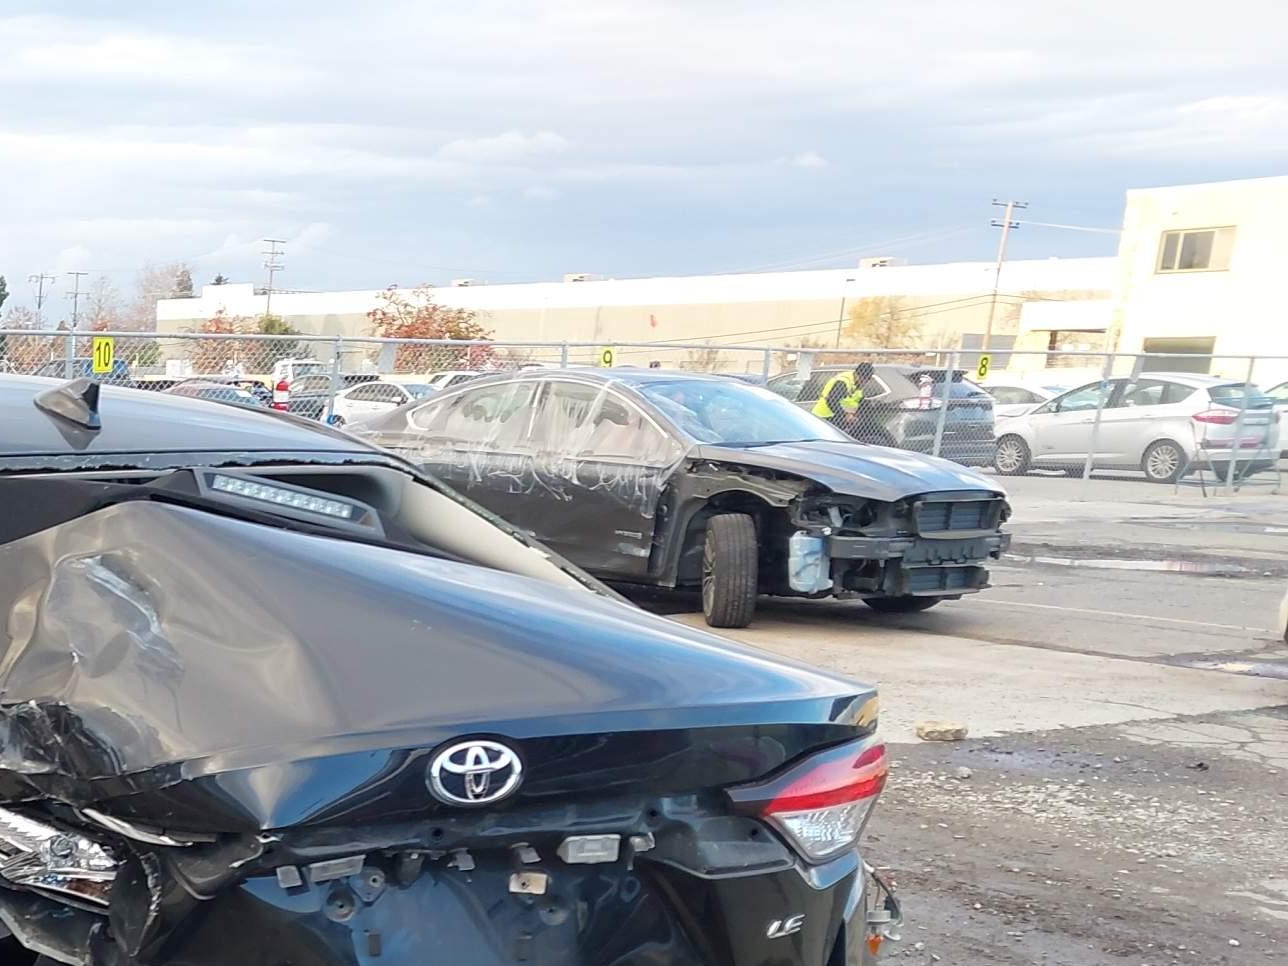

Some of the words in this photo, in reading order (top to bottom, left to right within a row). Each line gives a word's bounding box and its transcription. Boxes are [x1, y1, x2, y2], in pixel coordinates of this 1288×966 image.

[95, 341, 111, 368] 10
[602, 350, 613, 368] 9
[978, 356, 989, 377] 8
[767, 914, 806, 939] LE
